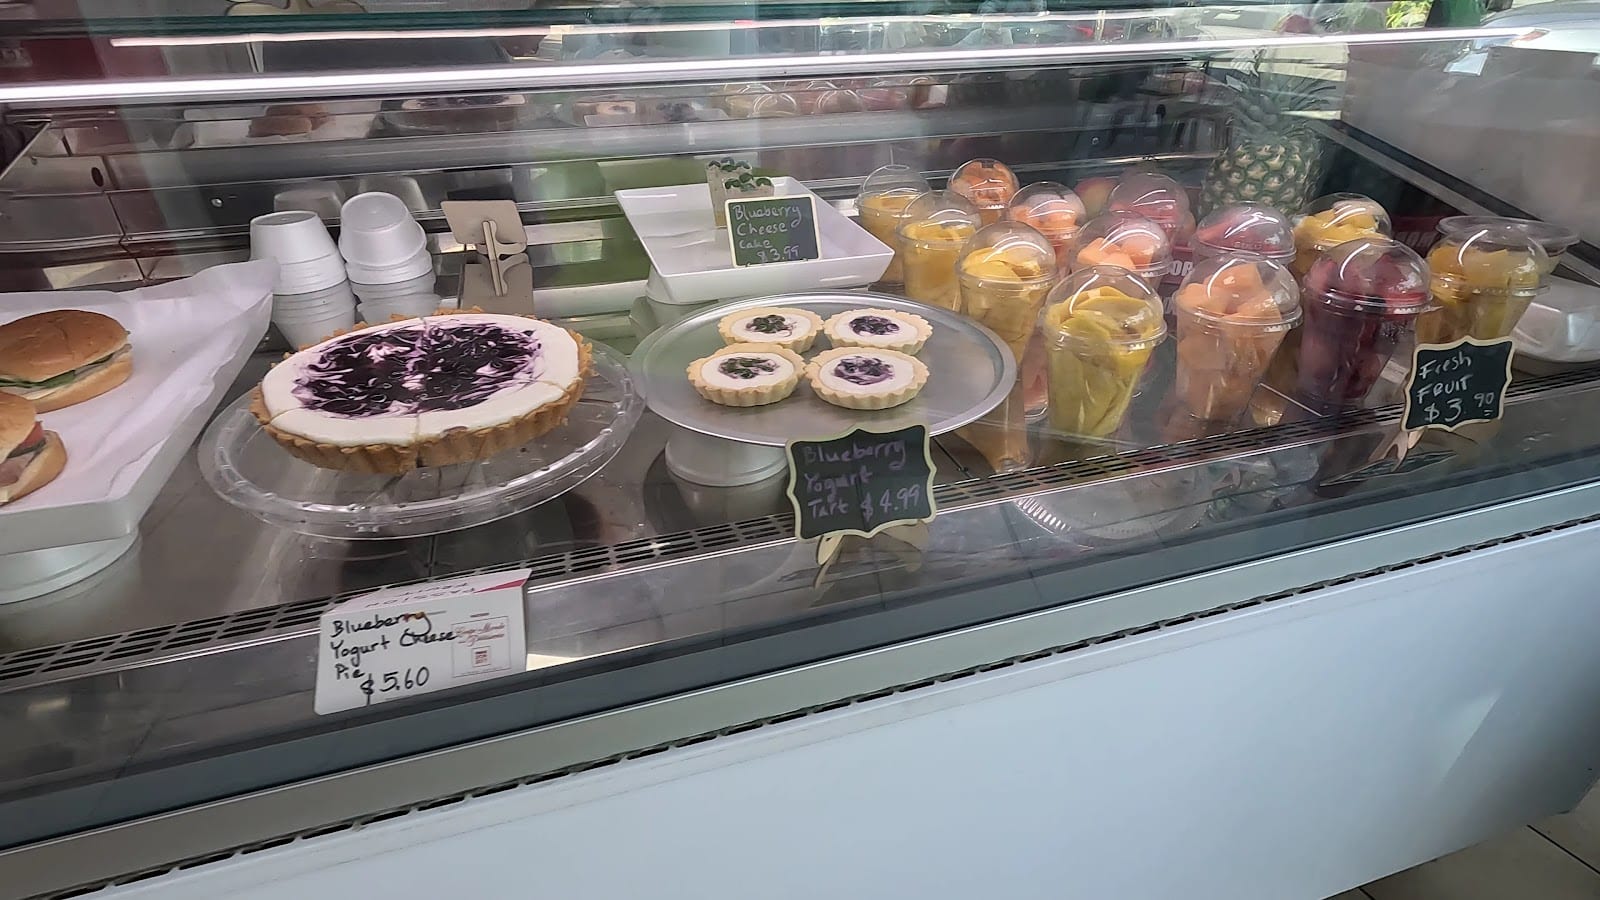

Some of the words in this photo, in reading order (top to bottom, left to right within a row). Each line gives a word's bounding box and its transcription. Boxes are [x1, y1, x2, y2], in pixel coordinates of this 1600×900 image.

[732, 204, 802, 229] Blueberry
[736, 222, 788, 237] Cheese
[1418, 351, 1472, 379] Fresh
[802, 439, 907, 471] Blueberry
[804, 464, 873, 503] Yogurt
[807, 498, 849, 519] Tart
[329, 611, 433, 638] Blueberry
[329, 634, 391, 668] Yogurt
[398, 628, 458, 648] Cheese
[334, 663, 366, 680] Pie
